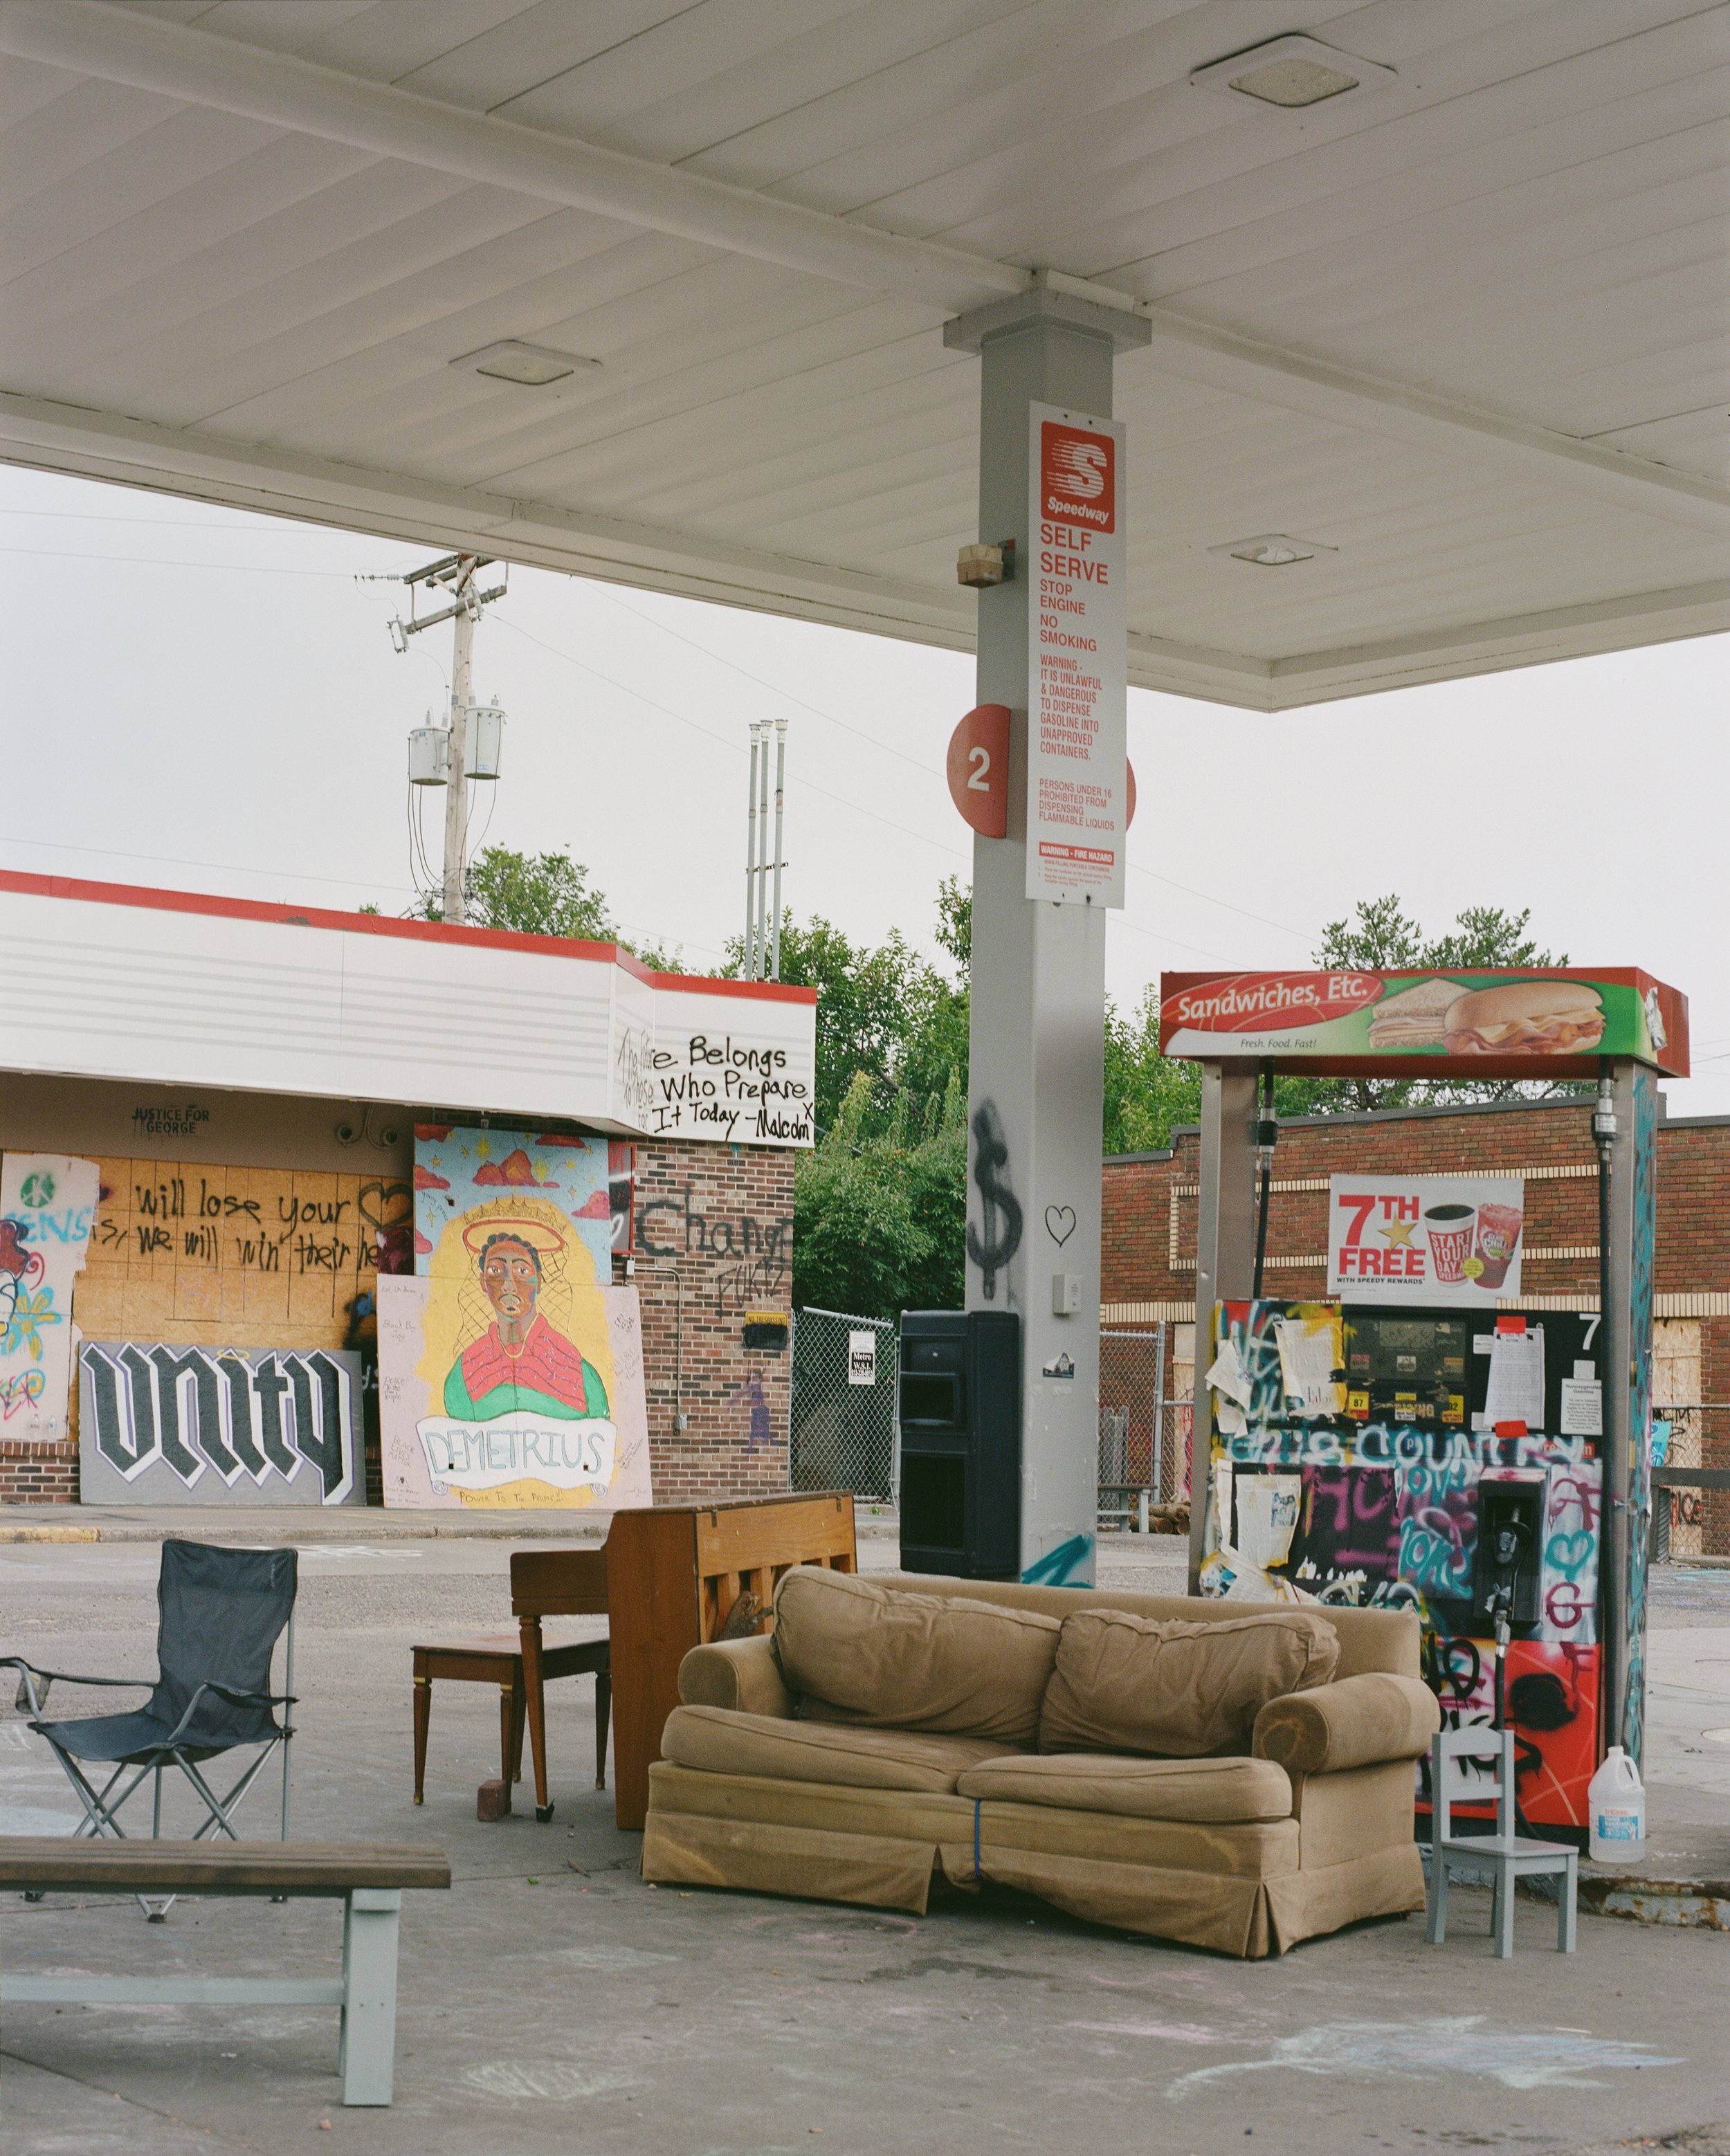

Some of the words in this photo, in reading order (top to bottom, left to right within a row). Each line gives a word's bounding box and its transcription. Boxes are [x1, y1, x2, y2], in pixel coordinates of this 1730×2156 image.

[1047, 495, 1109, 524] Speedway
[1040, 522, 1092, 551] SELF
[1040, 551, 1109, 585] SERVE
[1040, 579, 1073, 596] STOP
[1040, 595, 1086, 615] ENGINE
[1040, 613, 1058, 628] NO
[1040, 630, 1097, 652] SMOKING
[1040, 653, 1077, 672] WARNING
[1040, 668, 1049, 681] IT
[1050, 670, 1058, 683] IS
[1060, 670, 1103, 691] UNLAWFUL
[1041, 682, 1047, 695] &
[1049, 684, 1097, 704] DANGEROUS
[1040, 697, 1050, 711] TO
[1053, 697, 1091, 717] DISPENSE
[1040, 711, 1079, 729] GASOLINE
[1081, 718, 1099, 733] INTO
[1040, 725, 1093, 746] UNAPPROVED
[1040, 740, 1091, 760] CONTAINERS.
[967, 746, 990, 792] 2
[1039, 778, 1075, 793] PERSONS
[1077, 783, 1102, 796] UNDER
[1104, 788, 1112, 798] 16
[1039, 789, 1084, 805] PROHIBITED
[1086, 796, 1107, 808] FROM
[1039, 800, 1084, 816] DISPENSING
[1039, 811, 1084, 827] FLAMMABLE
[1086, 817, 1116, 831] LIQUIDS
[1040, 844, 1069, 857] WARNING
[1074, 849, 1088, 859] FIRE
[1089, 851, 1113, 864] HAZARD
[1178, 983, 1320, 1021] Sandwiches,
[1328, 976, 1367, 1000] Etc.
[1240, 1039, 1266, 1048] Fresh.
[1268, 1039, 1292, 1048] Food.
[1294, 1039, 1318, 1048] Fast!
[618, 1027, 638, 1084] The
[689, 1035, 786, 1077] Belongs
[660, 1072, 716, 1102] Who
[724, 1070, 808, 1107] Prepare
[132, 1107, 181, 1122] JUSTICE
[185, 1106, 210, 1122] FOR
[652, 1106, 682, 1133] It
[689, 1102, 740, 1141] Today
[146, 1122, 197, 1134] GEORGE
[136, 1178, 185, 1220] will
[199, 1178, 261, 1224] lose
[278, 1196, 351, 1244] your
[1430, 1230, 1471, 1248] START
[184, 1225, 218, 1271] will
[235, 1232, 279, 1272] win
[294, 1232, 351, 1275] their
[357, 1226, 379, 1271] he
[1434, 1244, 1470, 1261] YOUR
[1339, 1248, 1426, 1276] FREE
[1436, 1259, 1457, 1273] DAY
[1578, 1313, 1601, 1350] 7
[853, 1352, 872, 1361] Metro
[1354, 1398, 1363, 1407] 87
[425, 1429, 605, 1474] DEMETRIUS
